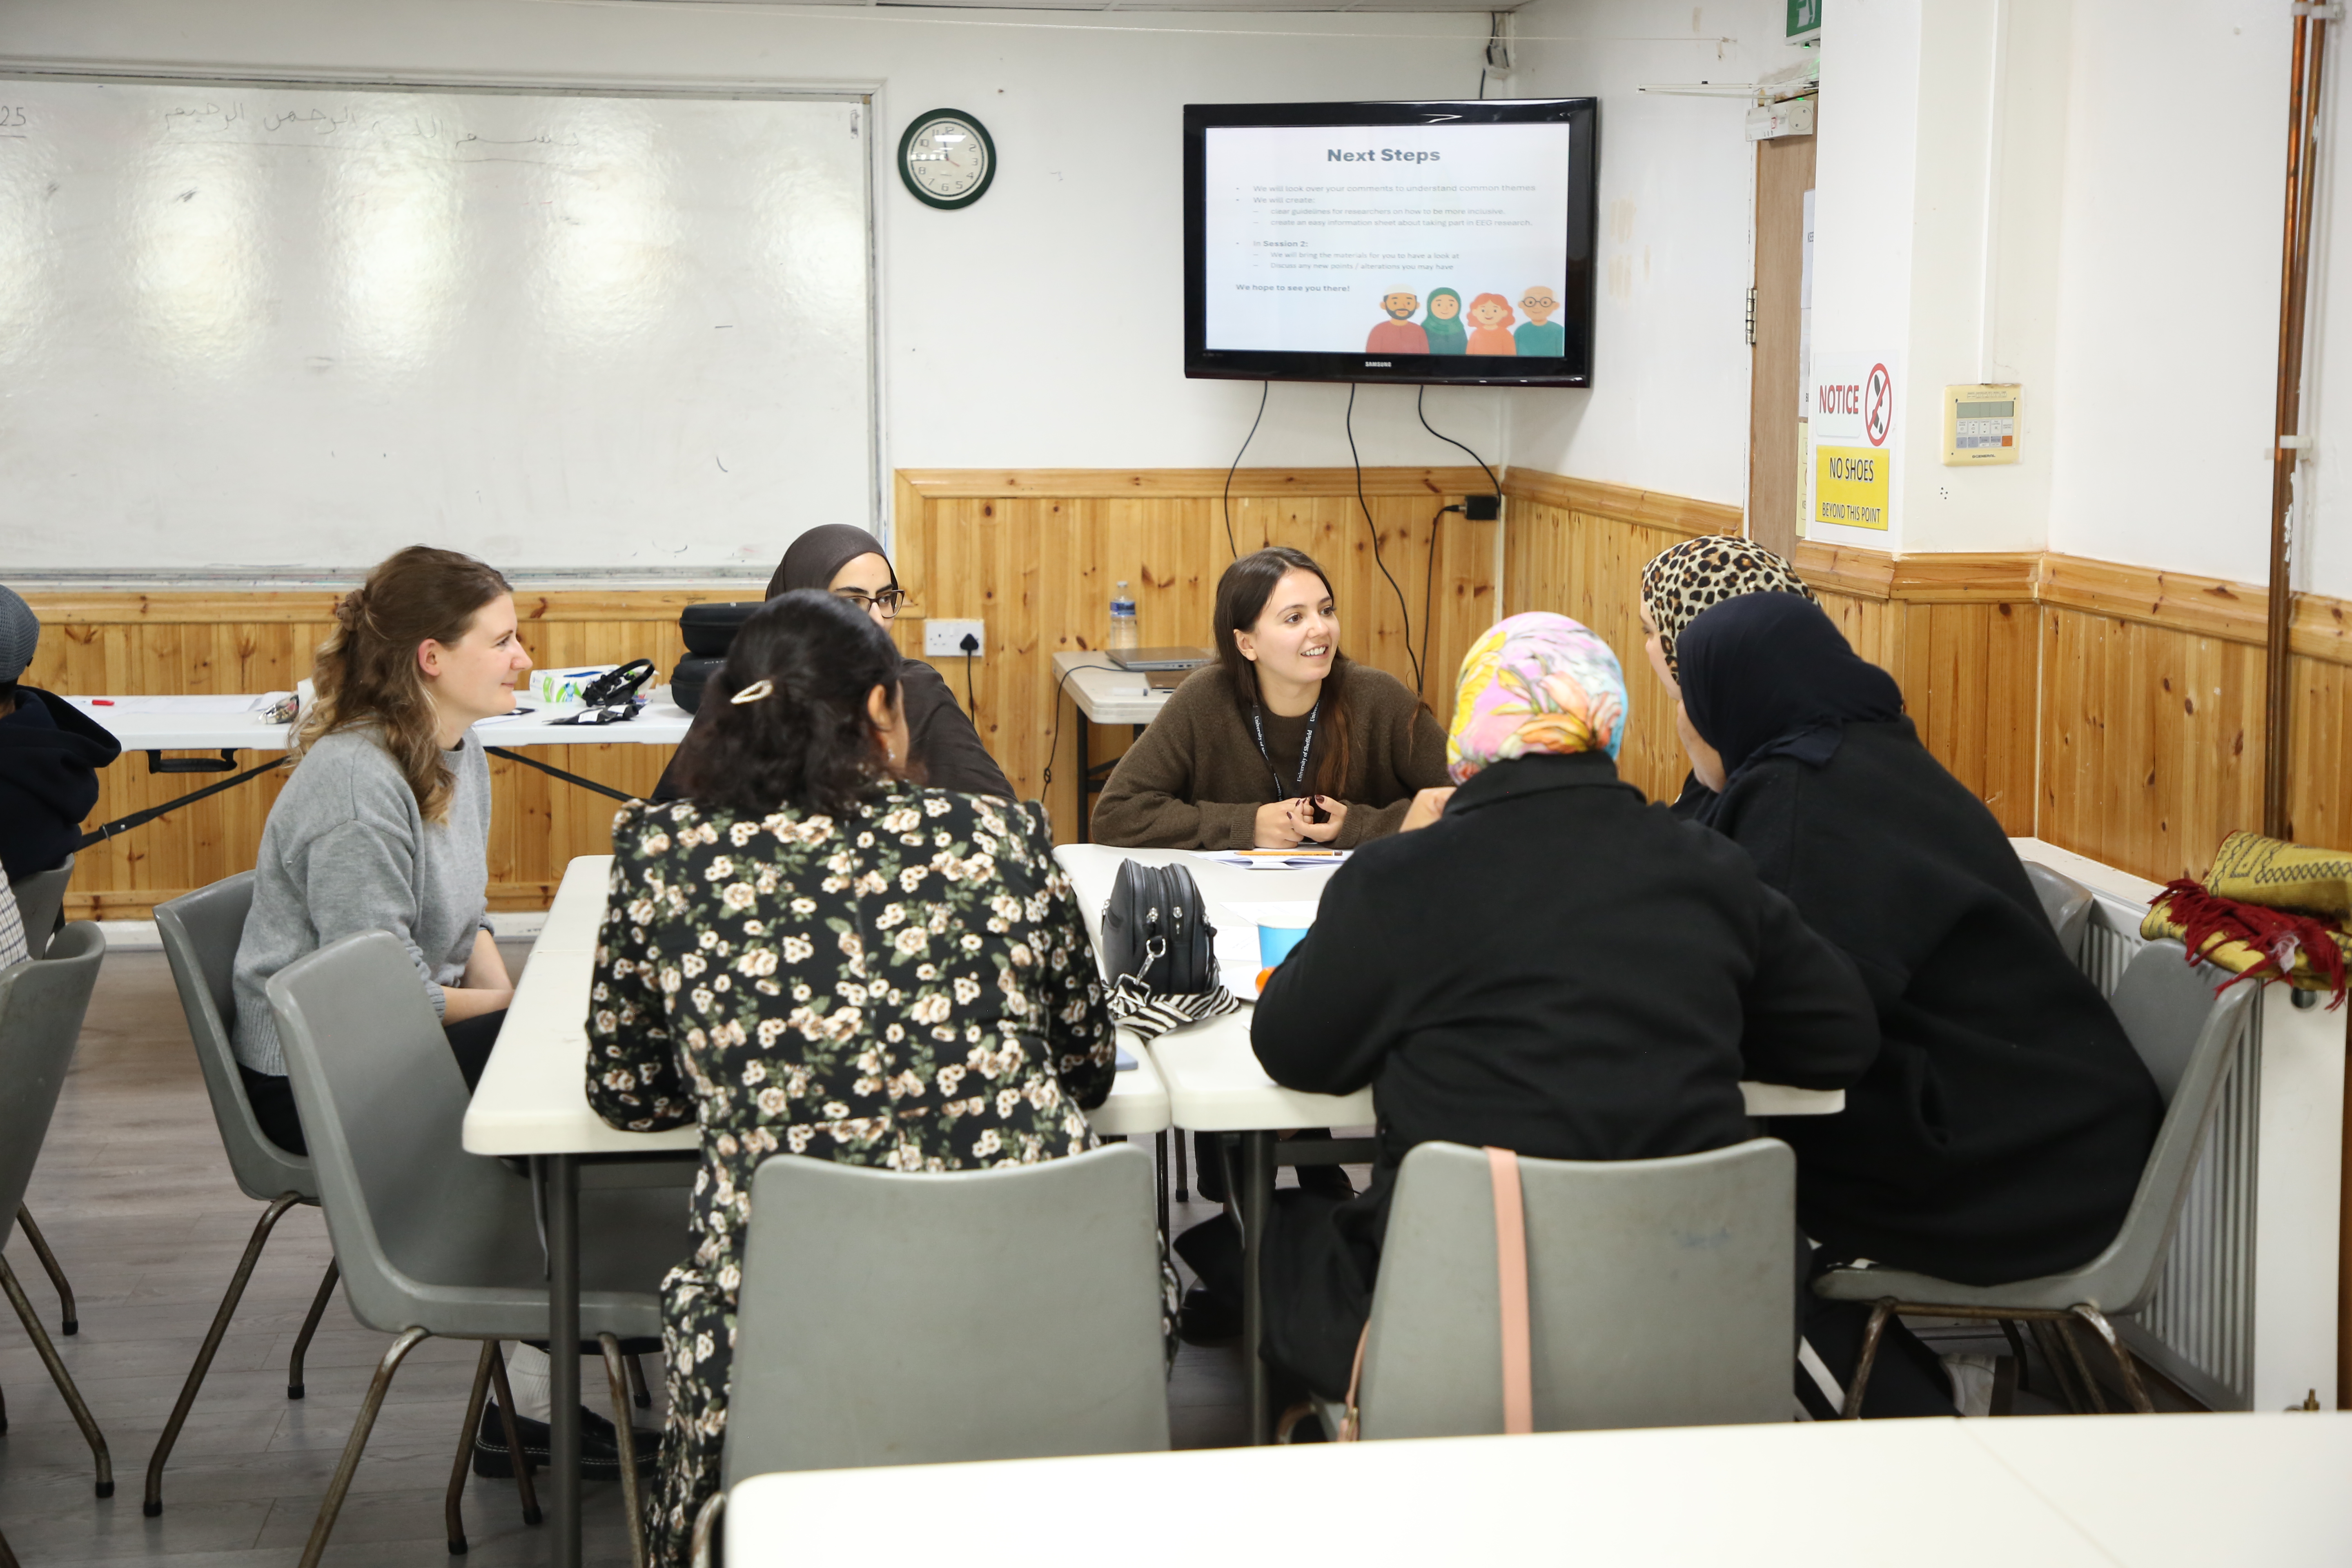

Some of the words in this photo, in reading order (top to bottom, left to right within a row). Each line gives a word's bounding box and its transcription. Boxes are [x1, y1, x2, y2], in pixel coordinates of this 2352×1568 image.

[920, 139, 929, 147] 10
[969, 144, 976, 152] 2
[971, 158, 978, 166] 3
[1327, 149, 1376, 162] Next
[1381, 148, 1441, 164] Steps
[919, 167, 926, 175] 8
[928, 177, 935, 186] 7
[956, 181, 963, 189] 5
[1819, 384, 1859, 414] NOTICE
[1829, 457, 1843, 479] NO
[1845, 458, 1874, 482] SHOES
[1822, 502, 1845, 519] BEYOND
[1846, 505, 1860, 521] THIS
[1861, 506, 1881, 523] POINT
[1254, 715, 1263, 741] University
[1297, 758, 1307, 782] University
[1303, 729, 1313, 752] Sheffield
